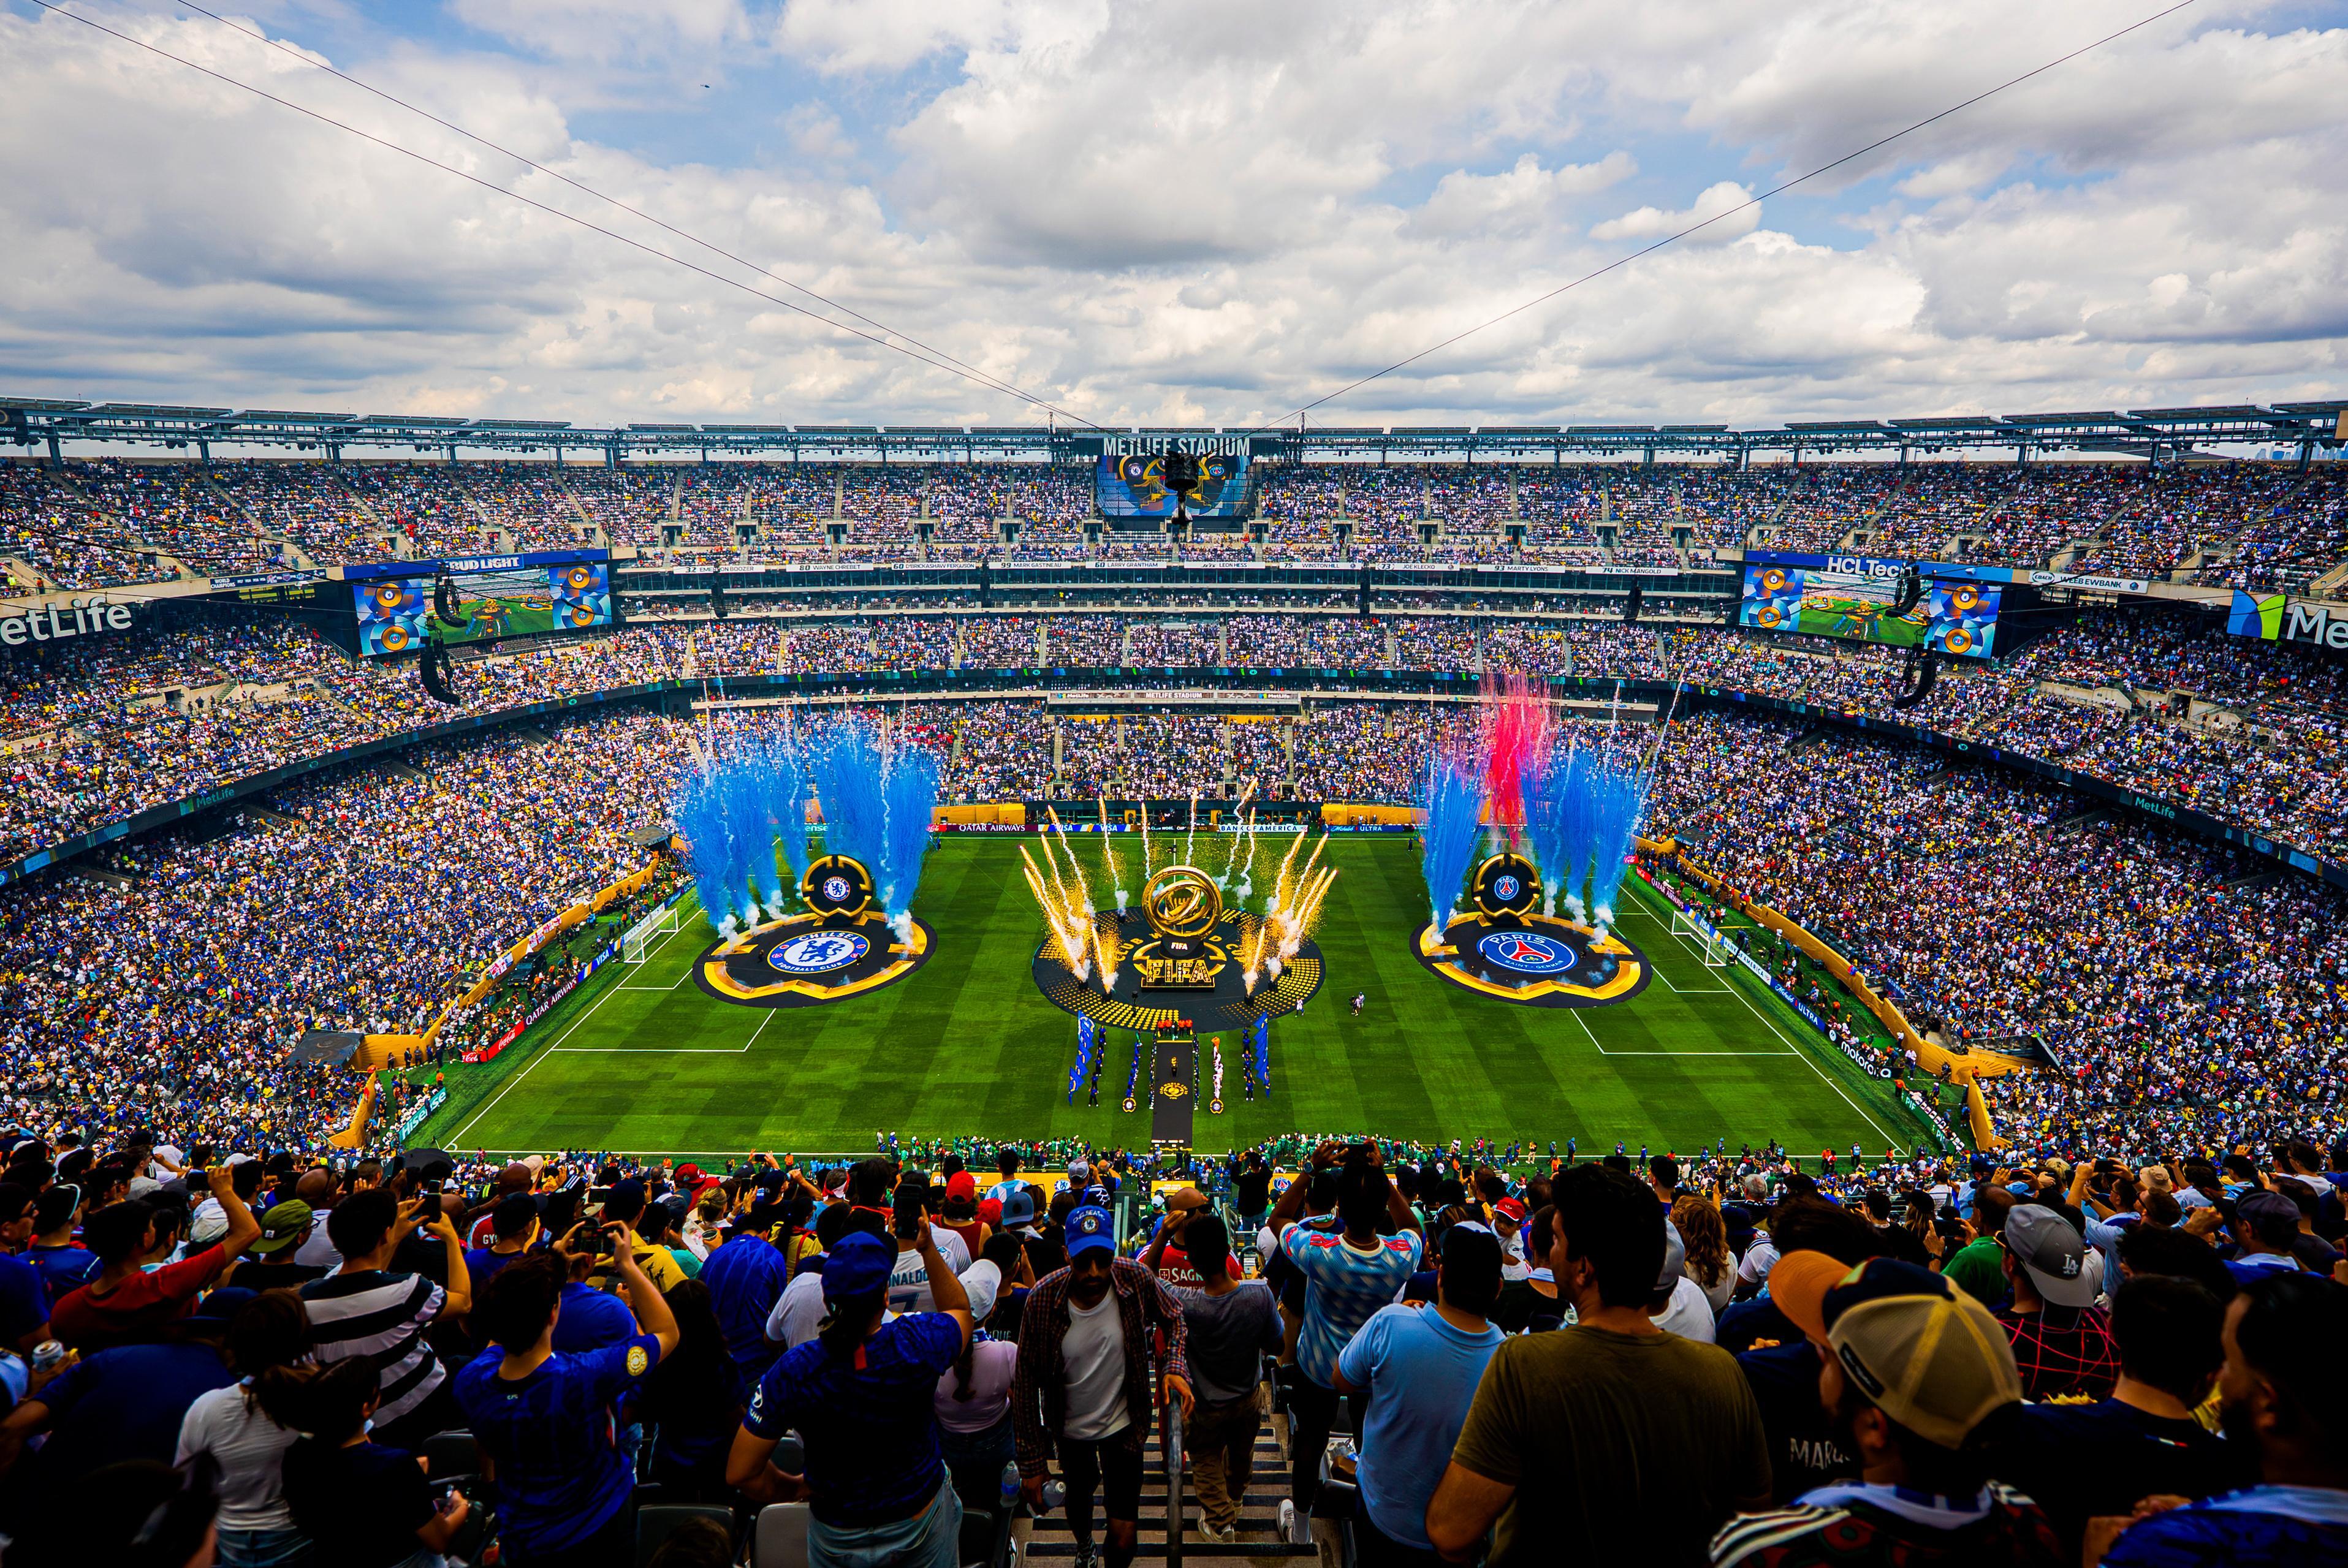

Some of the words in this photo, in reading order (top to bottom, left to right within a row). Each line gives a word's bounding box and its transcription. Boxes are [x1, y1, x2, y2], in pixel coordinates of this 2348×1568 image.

[1104, 437, 1172, 456] METLIFE
[1178, 437, 1250, 456] STADIUM
[449, 558, 477, 572] BUD
[481, 556, 520, 570] LIGHT
[2060, 575, 2084, 586] WEEB
[2084, 578, 2122, 588] EWBANK
[196, 788, 235, 808] MetLife
[2135, 797, 2175, 819] MetLife
[959, 824, 987, 832] QATAR
[1651, 877, 1666, 893] QATAR
[1666, 890, 1684, 909] AIRWAYS
[798, 931, 860, 942] CHELSEA
[1489, 934, 1546, 945] PARIS
[1171, 942, 1188, 950] FIFA
[596, 949, 610, 966] VISA
[1724, 940, 1739, 955] BANK
[1744, 955, 1764, 977] AMERICA
[777, 962, 816, 973] FOOTBALL
[819, 961, 843, 971] CLUB
[1146, 960, 1212, 983] FIFA
[526, 1001, 550, 1026] QATAR
[551, 979, 577, 1006] AIRWAYS
[1798, 1003, 1818, 1026] ULTRA
[1905, 1096, 1917, 1110] PIF
[889, 1292, 920, 1312] 7
